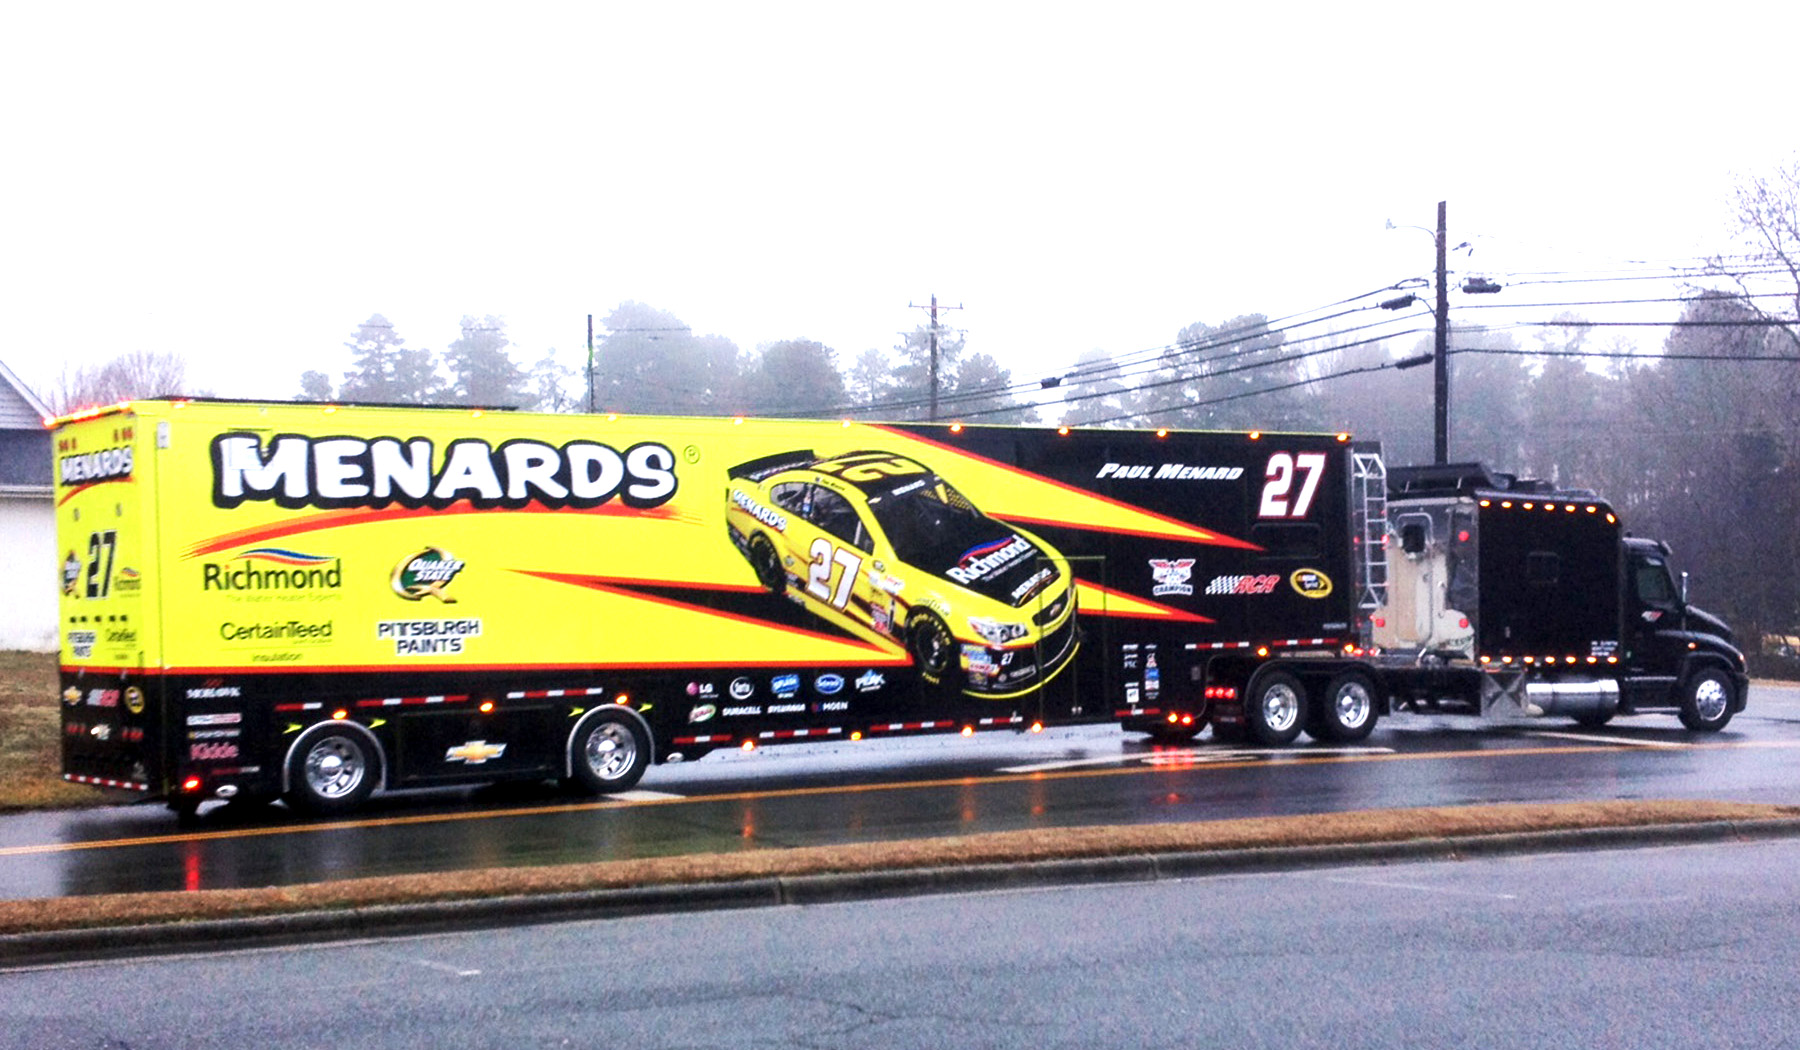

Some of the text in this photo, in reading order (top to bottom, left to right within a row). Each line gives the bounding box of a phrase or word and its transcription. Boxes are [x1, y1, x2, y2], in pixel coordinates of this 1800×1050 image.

[211, 433, 679, 509] MENARDS
[1258, 452, 1326, 518] 27
[86, 531, 117, 599] 27
[203, 558, 341, 591] Richmond
[414, 570, 455, 582] STATE
[806, 537, 863, 611] 27
[947, 534, 1032, 584] Richmond
[219, 621, 332, 641] CertainTeed
[378, 620, 479, 637] PITTSBURGH
[397, 637, 461, 654] PAINTS
